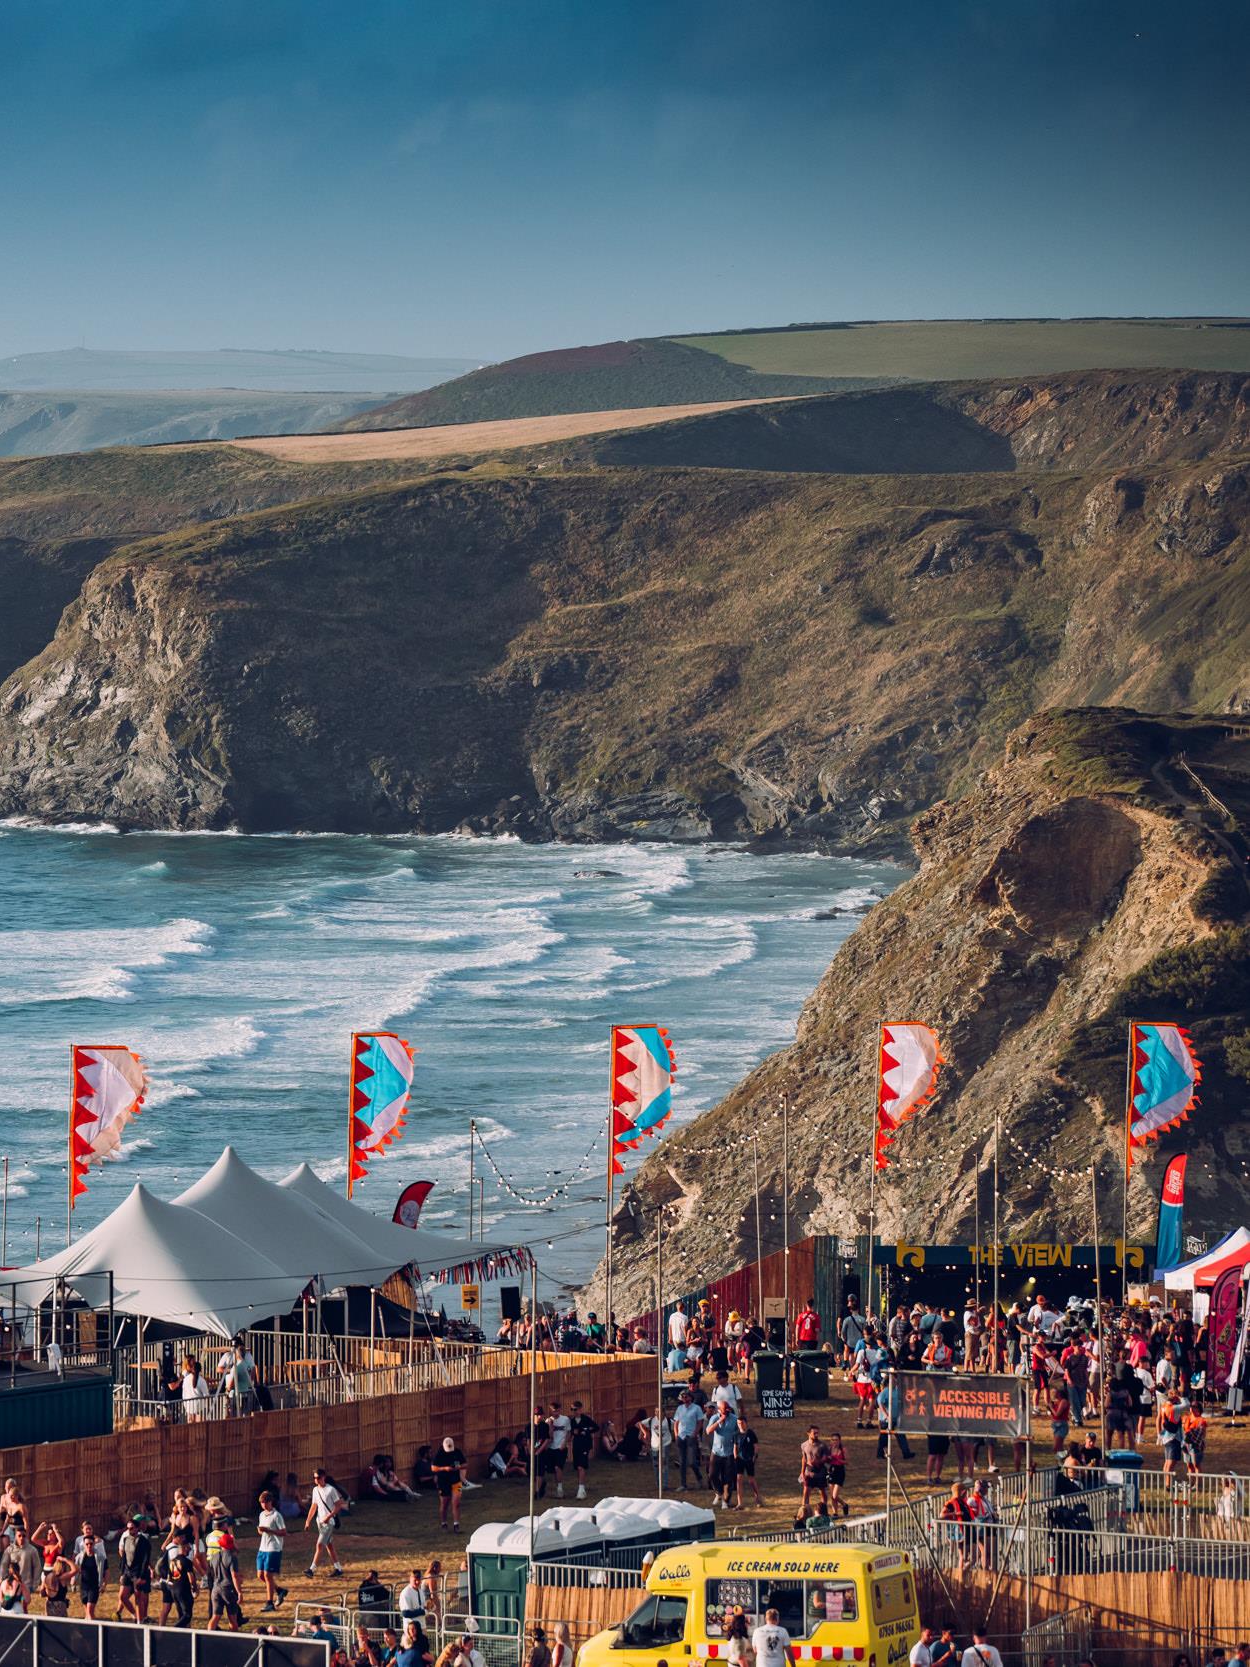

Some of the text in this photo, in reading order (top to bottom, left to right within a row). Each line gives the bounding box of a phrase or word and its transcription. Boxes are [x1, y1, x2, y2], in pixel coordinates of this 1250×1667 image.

[968, 1243, 1004, 1266] THE
[805, 1317, 811, 1330] 8
[762, 1397, 783, 1409] WIN
[938, 1389, 1010, 1406] ACCESSIBLE
[763, 1409, 778, 1417] FREE
[933, 1404, 1017, 1421] VIEWING AREA
[727, 1561, 840, 1573] ICE CREAM SOLD HERE
